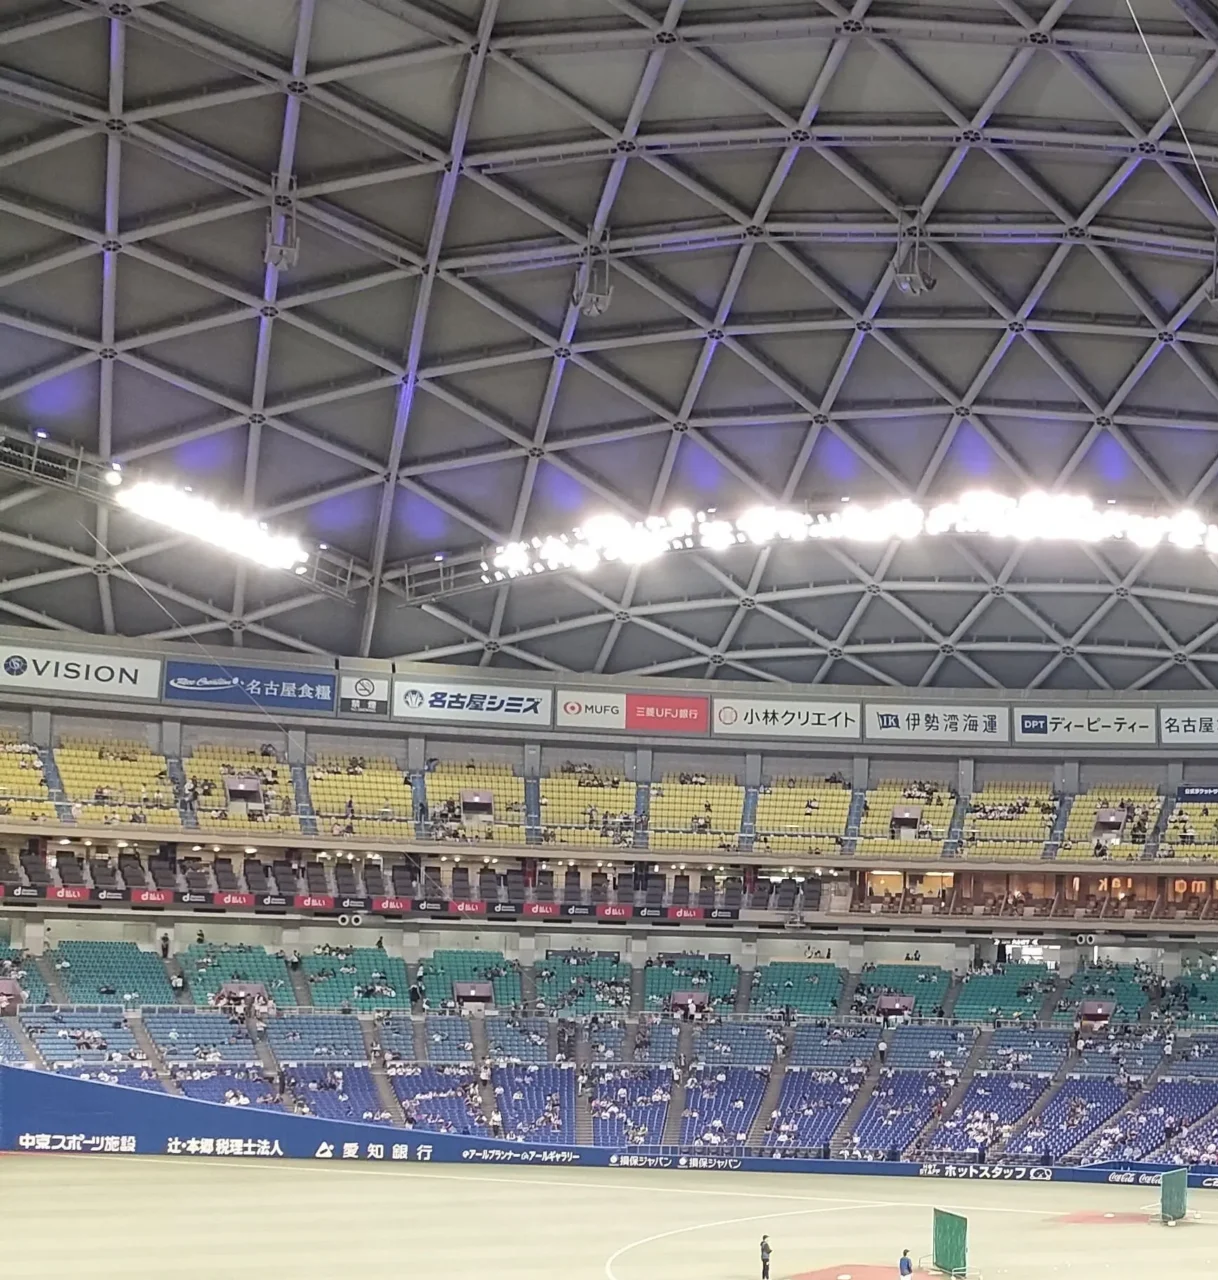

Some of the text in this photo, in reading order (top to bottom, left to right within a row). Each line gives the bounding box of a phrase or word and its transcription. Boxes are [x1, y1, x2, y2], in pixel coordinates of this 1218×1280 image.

[32, 659, 139, 685] VISION
[245, 678, 332, 701] 名古屋食糧
[429, 692, 543, 715] 名古屋シミズ
[584, 705, 620, 716] MUFG
[636, 706, 699, 720] 三菱UFJ銀行
[743, 708, 856, 728] 小林クリエイト
[905, 712, 998, 734] 伊勢湾海運
[1024, 719, 1045, 730] DPT
[1050, 716, 1150, 733] ディーピーティー
[19, 1133, 137, 1153] 中京スポーツ施設
[343, 1143, 432, 1161] 愛知銀行
[469, 1149, 580, 1162] アールプランナー アールギャラリー
[620, 1155, 672, 1167] 損保ジャパン
[689, 1158, 742, 1169] 損保ジャパン
[945, 1164, 1027, 1179] ホットスタッフ
